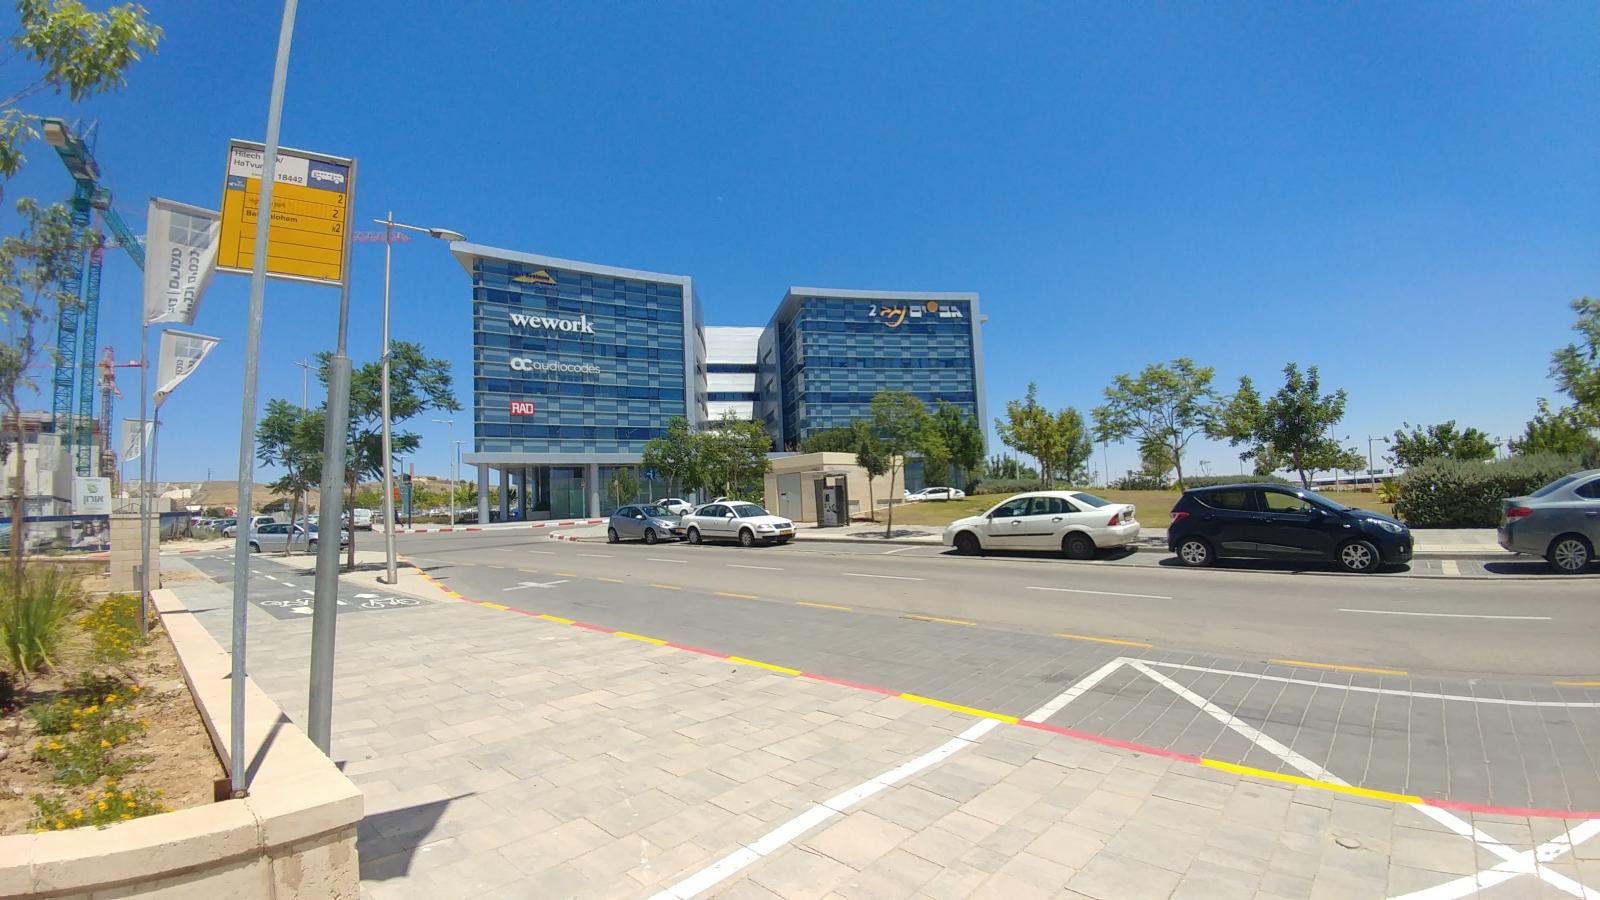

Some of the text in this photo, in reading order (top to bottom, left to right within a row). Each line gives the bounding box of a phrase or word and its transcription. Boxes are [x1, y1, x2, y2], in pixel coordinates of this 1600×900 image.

[278, 174, 303, 184] 18442
[337, 195, 344, 204] 2
[332, 209, 339, 219] 2
[868, 304, 877, 316] 2
[509, 313, 596, 334] wework
[532, 361, 601, 374] audiocodes
[511, 402, 534, 414] RAD
